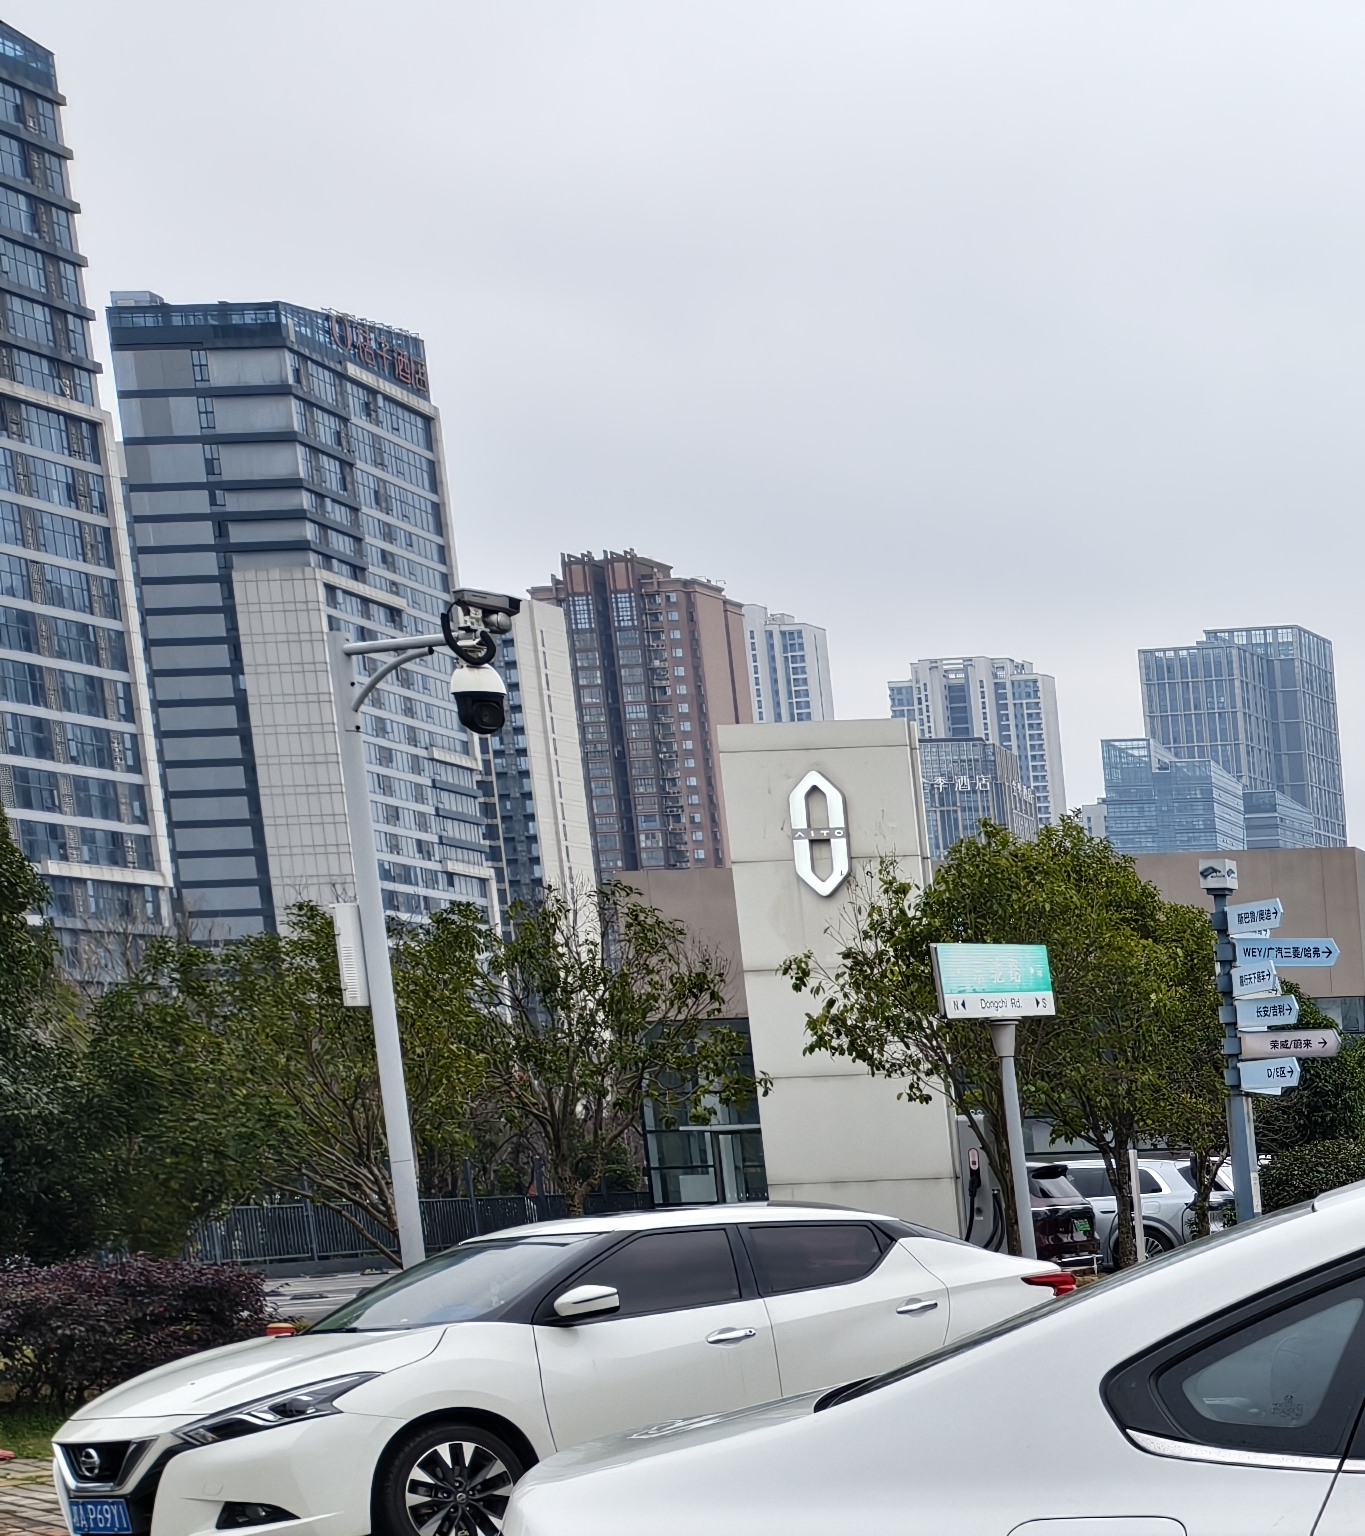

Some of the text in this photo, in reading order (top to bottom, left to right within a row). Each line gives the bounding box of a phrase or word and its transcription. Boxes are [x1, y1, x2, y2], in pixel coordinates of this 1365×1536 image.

[921, 774, 991, 792] 季酒店
[795, 829, 843, 838] AITO
[1256, 1004, 1285, 1018] 长安/吉利
